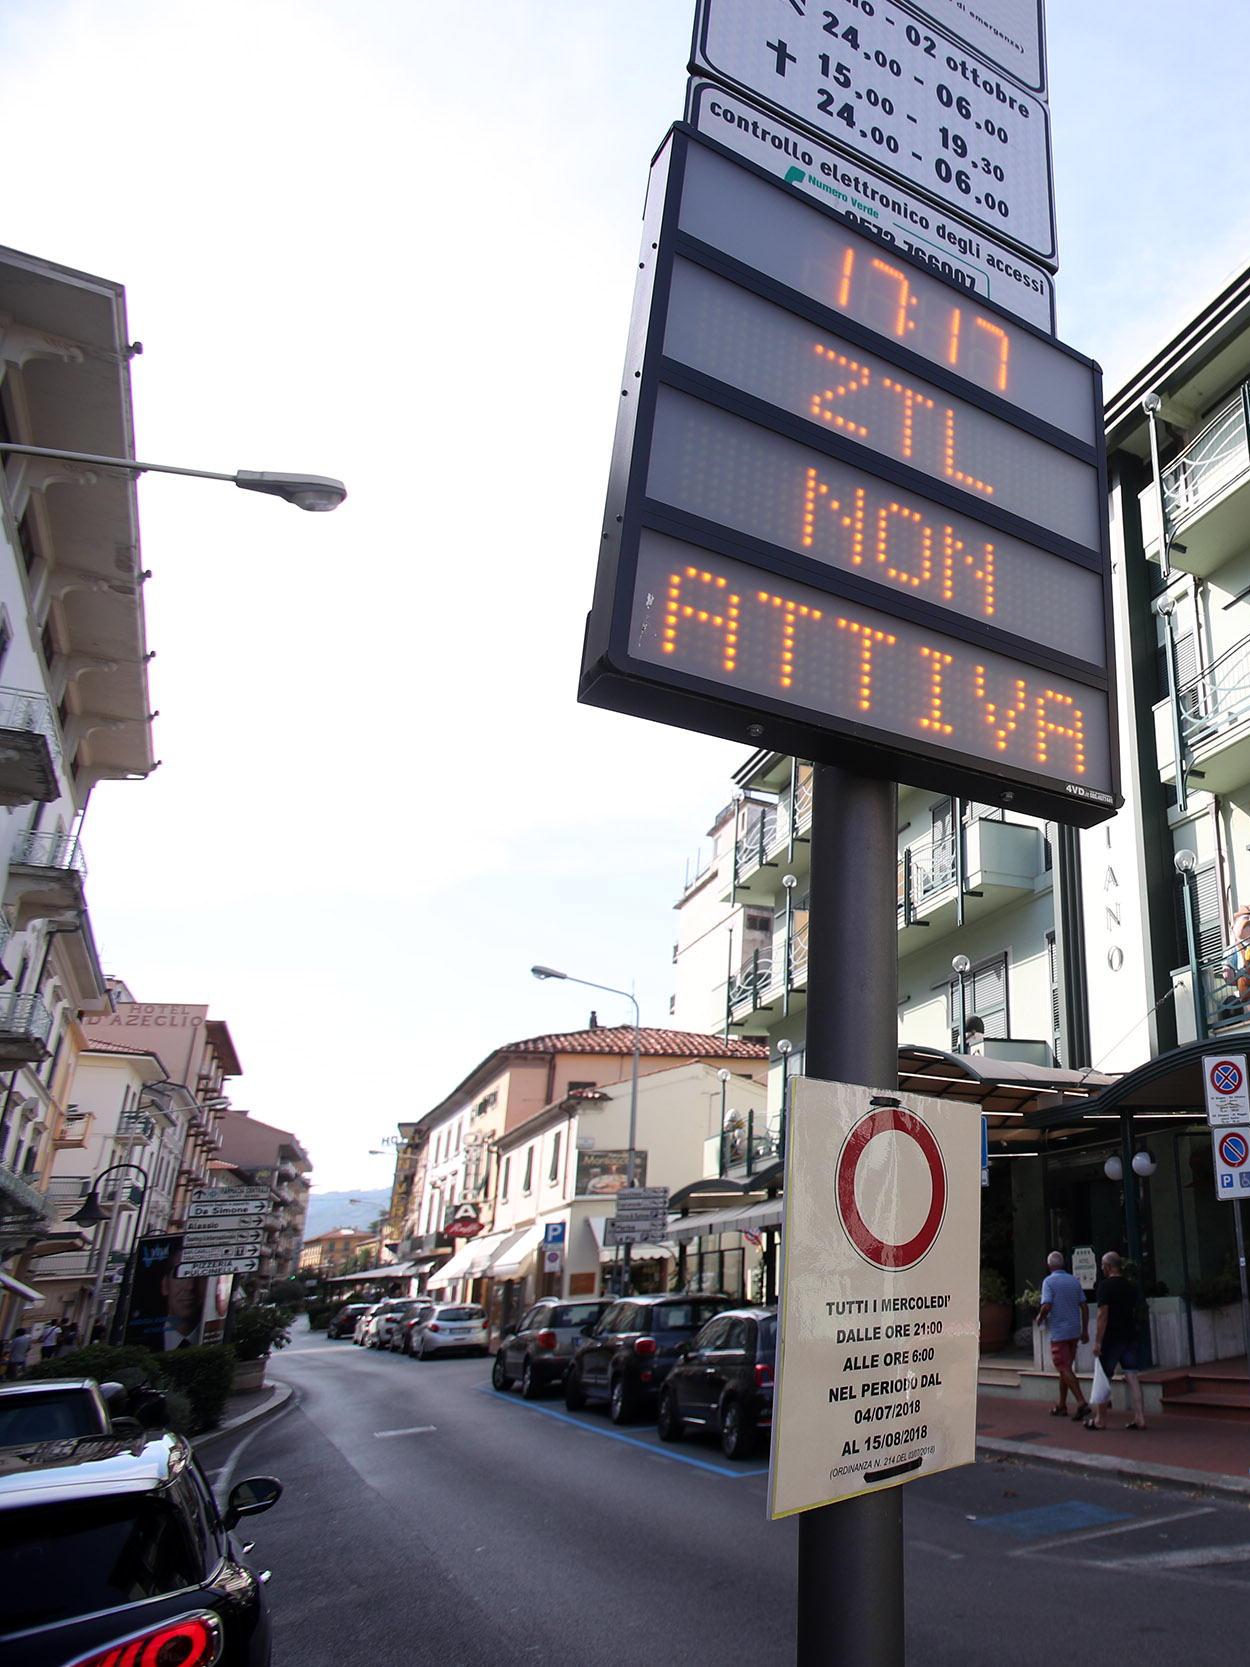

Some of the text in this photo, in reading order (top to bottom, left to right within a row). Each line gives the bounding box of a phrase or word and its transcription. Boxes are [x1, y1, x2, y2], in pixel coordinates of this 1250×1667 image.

[969, 11, 1024, 54] emergenza)
[905, 24, 936, 59] 02
[946, 56, 1030, 119] ottobre
[709, 101, 1045, 296] controllo elettronico degli accessi
[808, 174, 880, 219] Numero Verde
[839, 246, 1011, 392] 17:17
[810, 343, 994, 495] ZTL
[801, 467, 996, 617] NON
[662, 566, 1086, 774] ATTIVA
[213, 1206, 249, 1215] Simone
[826, 1295, 950, 1316] TUTTI I MERCOLEDI'
[836, 1320, 942, 1344] DALLE ORE 21:00
[842, 1347, 935, 1372] ALLE ORE 6:00
[828, 1373, 942, 1403] NEL PERIODO DAL
[854, 1399, 921, 1424] 04/07/2018
[841, 1424, 928, 1457] AL 15/08/2018
